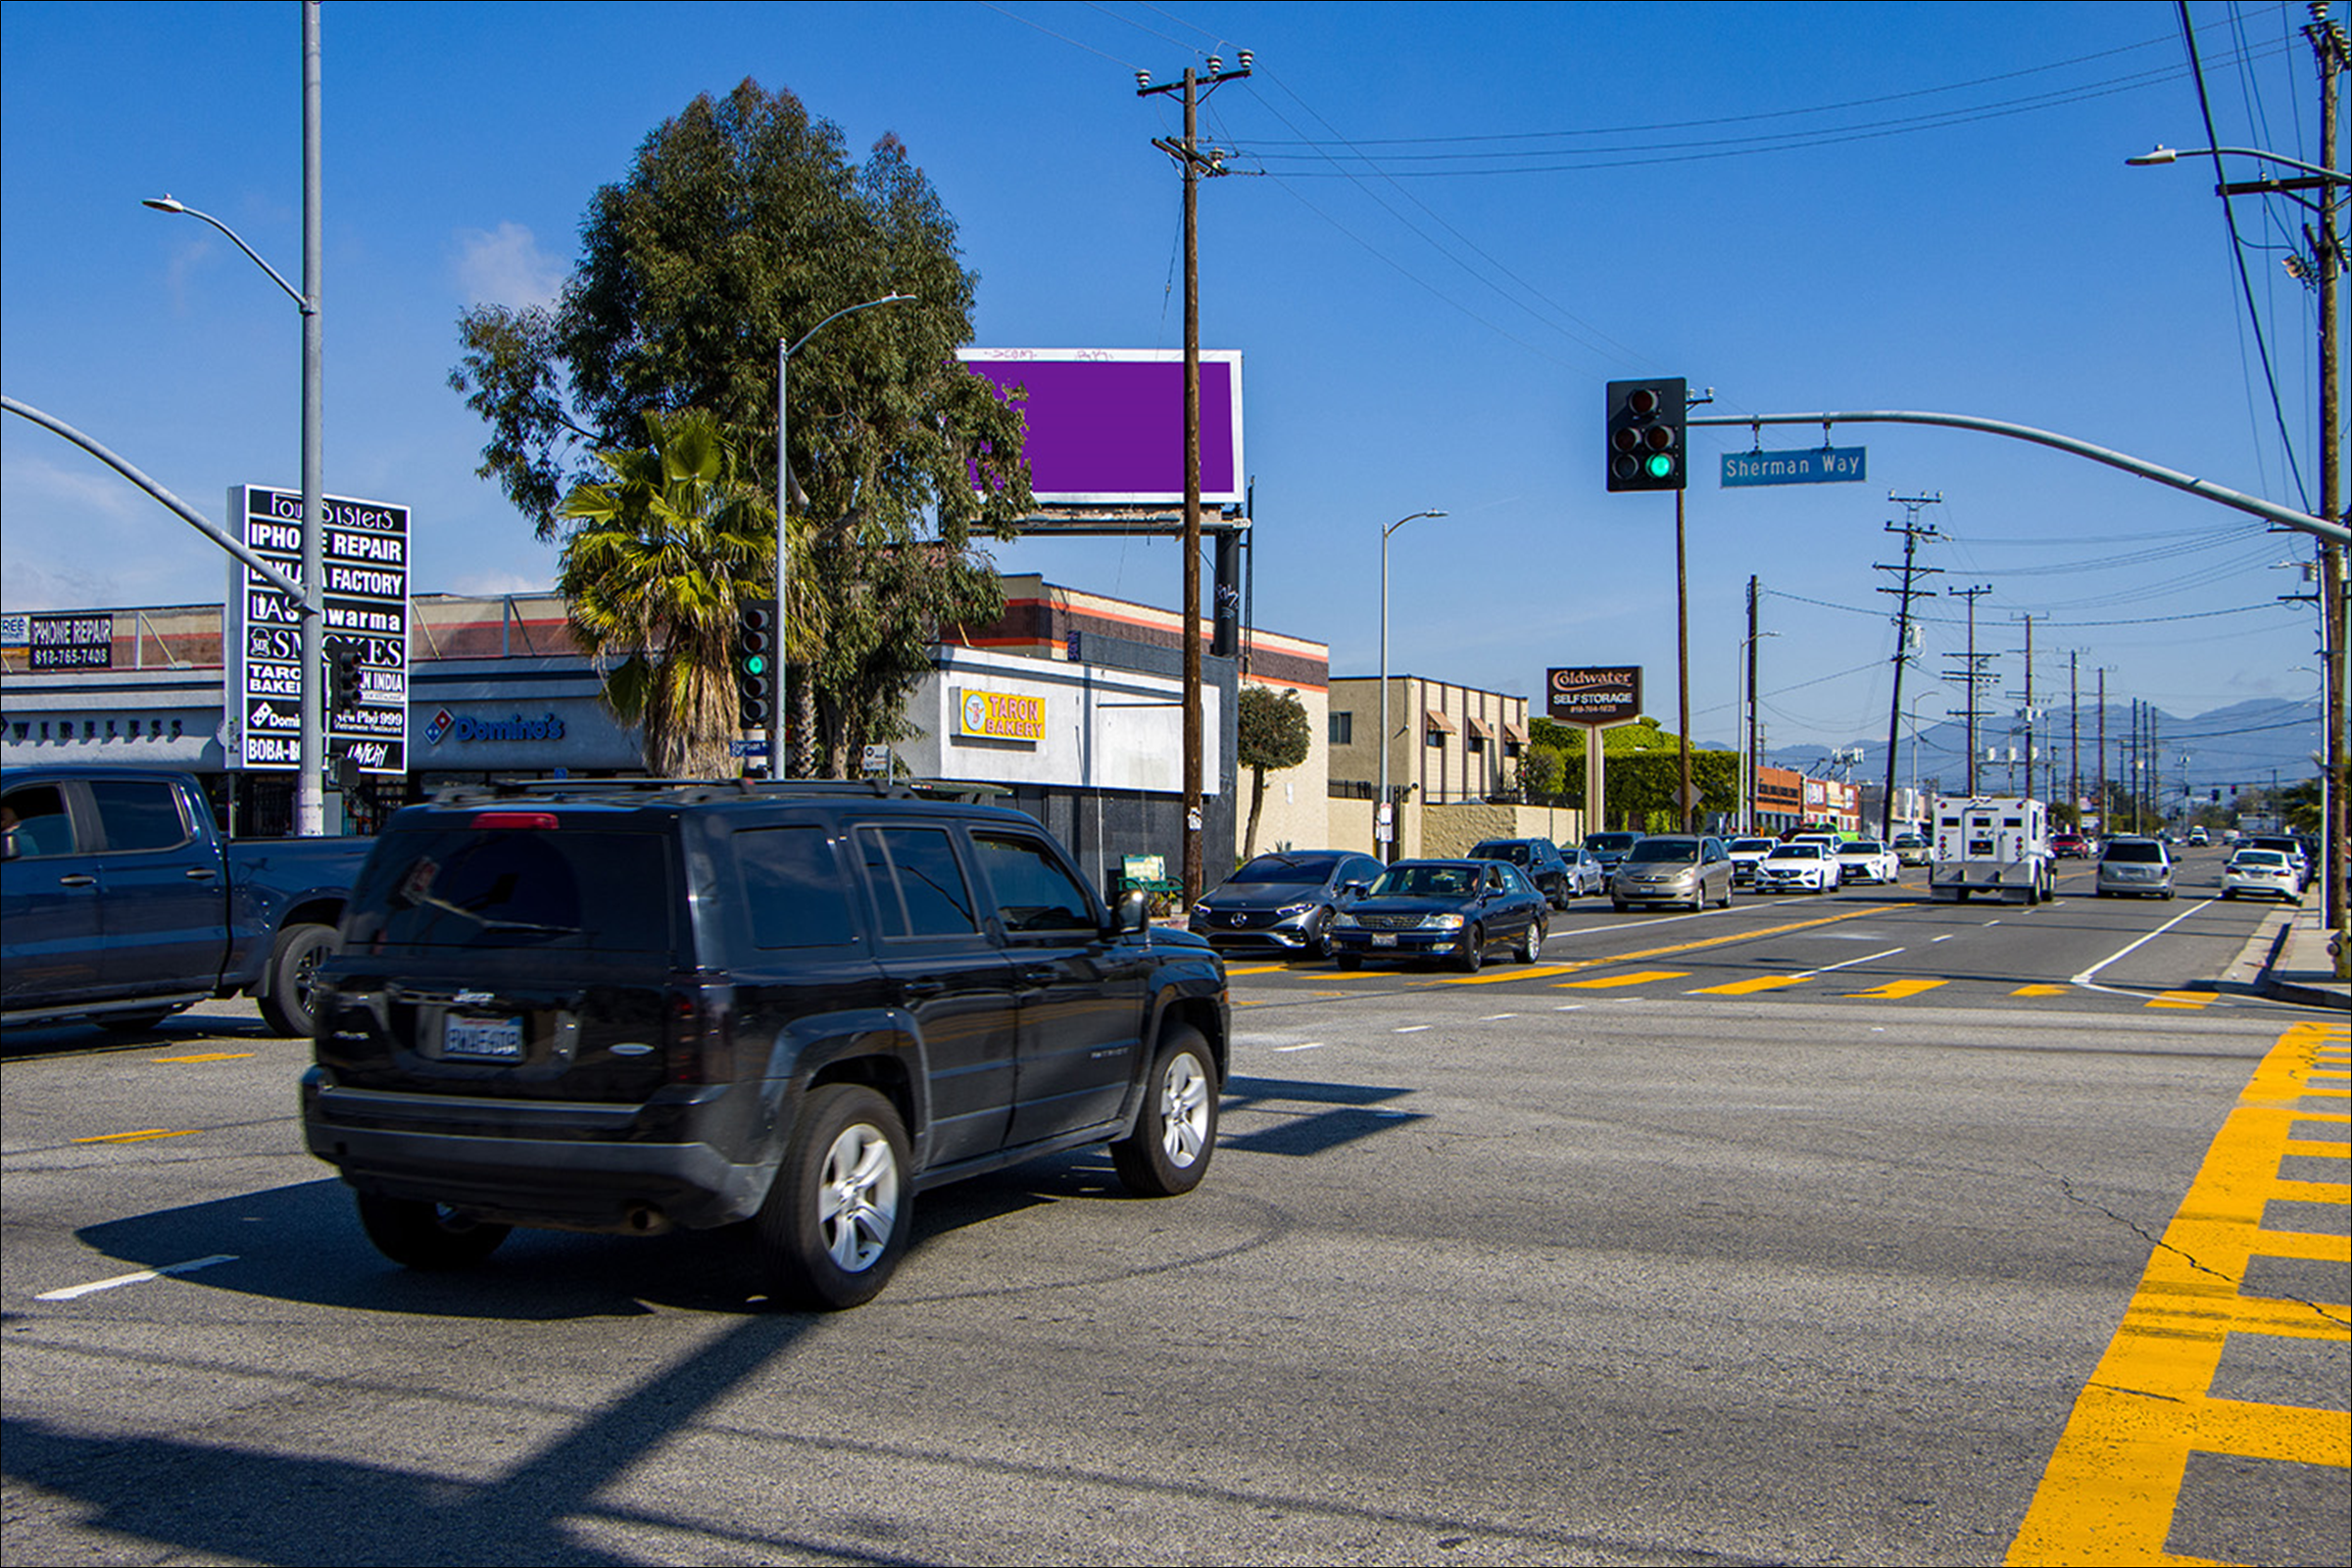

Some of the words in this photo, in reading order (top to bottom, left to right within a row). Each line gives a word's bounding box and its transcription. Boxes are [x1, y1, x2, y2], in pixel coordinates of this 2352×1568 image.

[1726, 460, 1809, 477] Sherman
[1822, 455, 1859, 474] Way
[271, 492, 303, 518] Fou
[251, 522, 327, 553] IPHOE
[333, 533, 403, 563] REPAIR
[331, 567, 404, 596] FACTORY
[32, 620, 72, 645] PHONE
[74, 618, 113, 643] REPAIR
[249, 664, 302, 681] TARO
[372, 670, 404, 692] INDIA
[1552, 670, 1634, 692] Coldwater
[989, 696, 1038, 721] TARON
[1553, 693, 1580, 705] SELF
[1581, 693, 1634, 705] STORAGE
[12, 719, 183, 739] WIRELESS
[379, 711, 403, 726] 999
[455, 713, 564, 742] Domino's
[985, 718, 1043, 737] BAKERY
